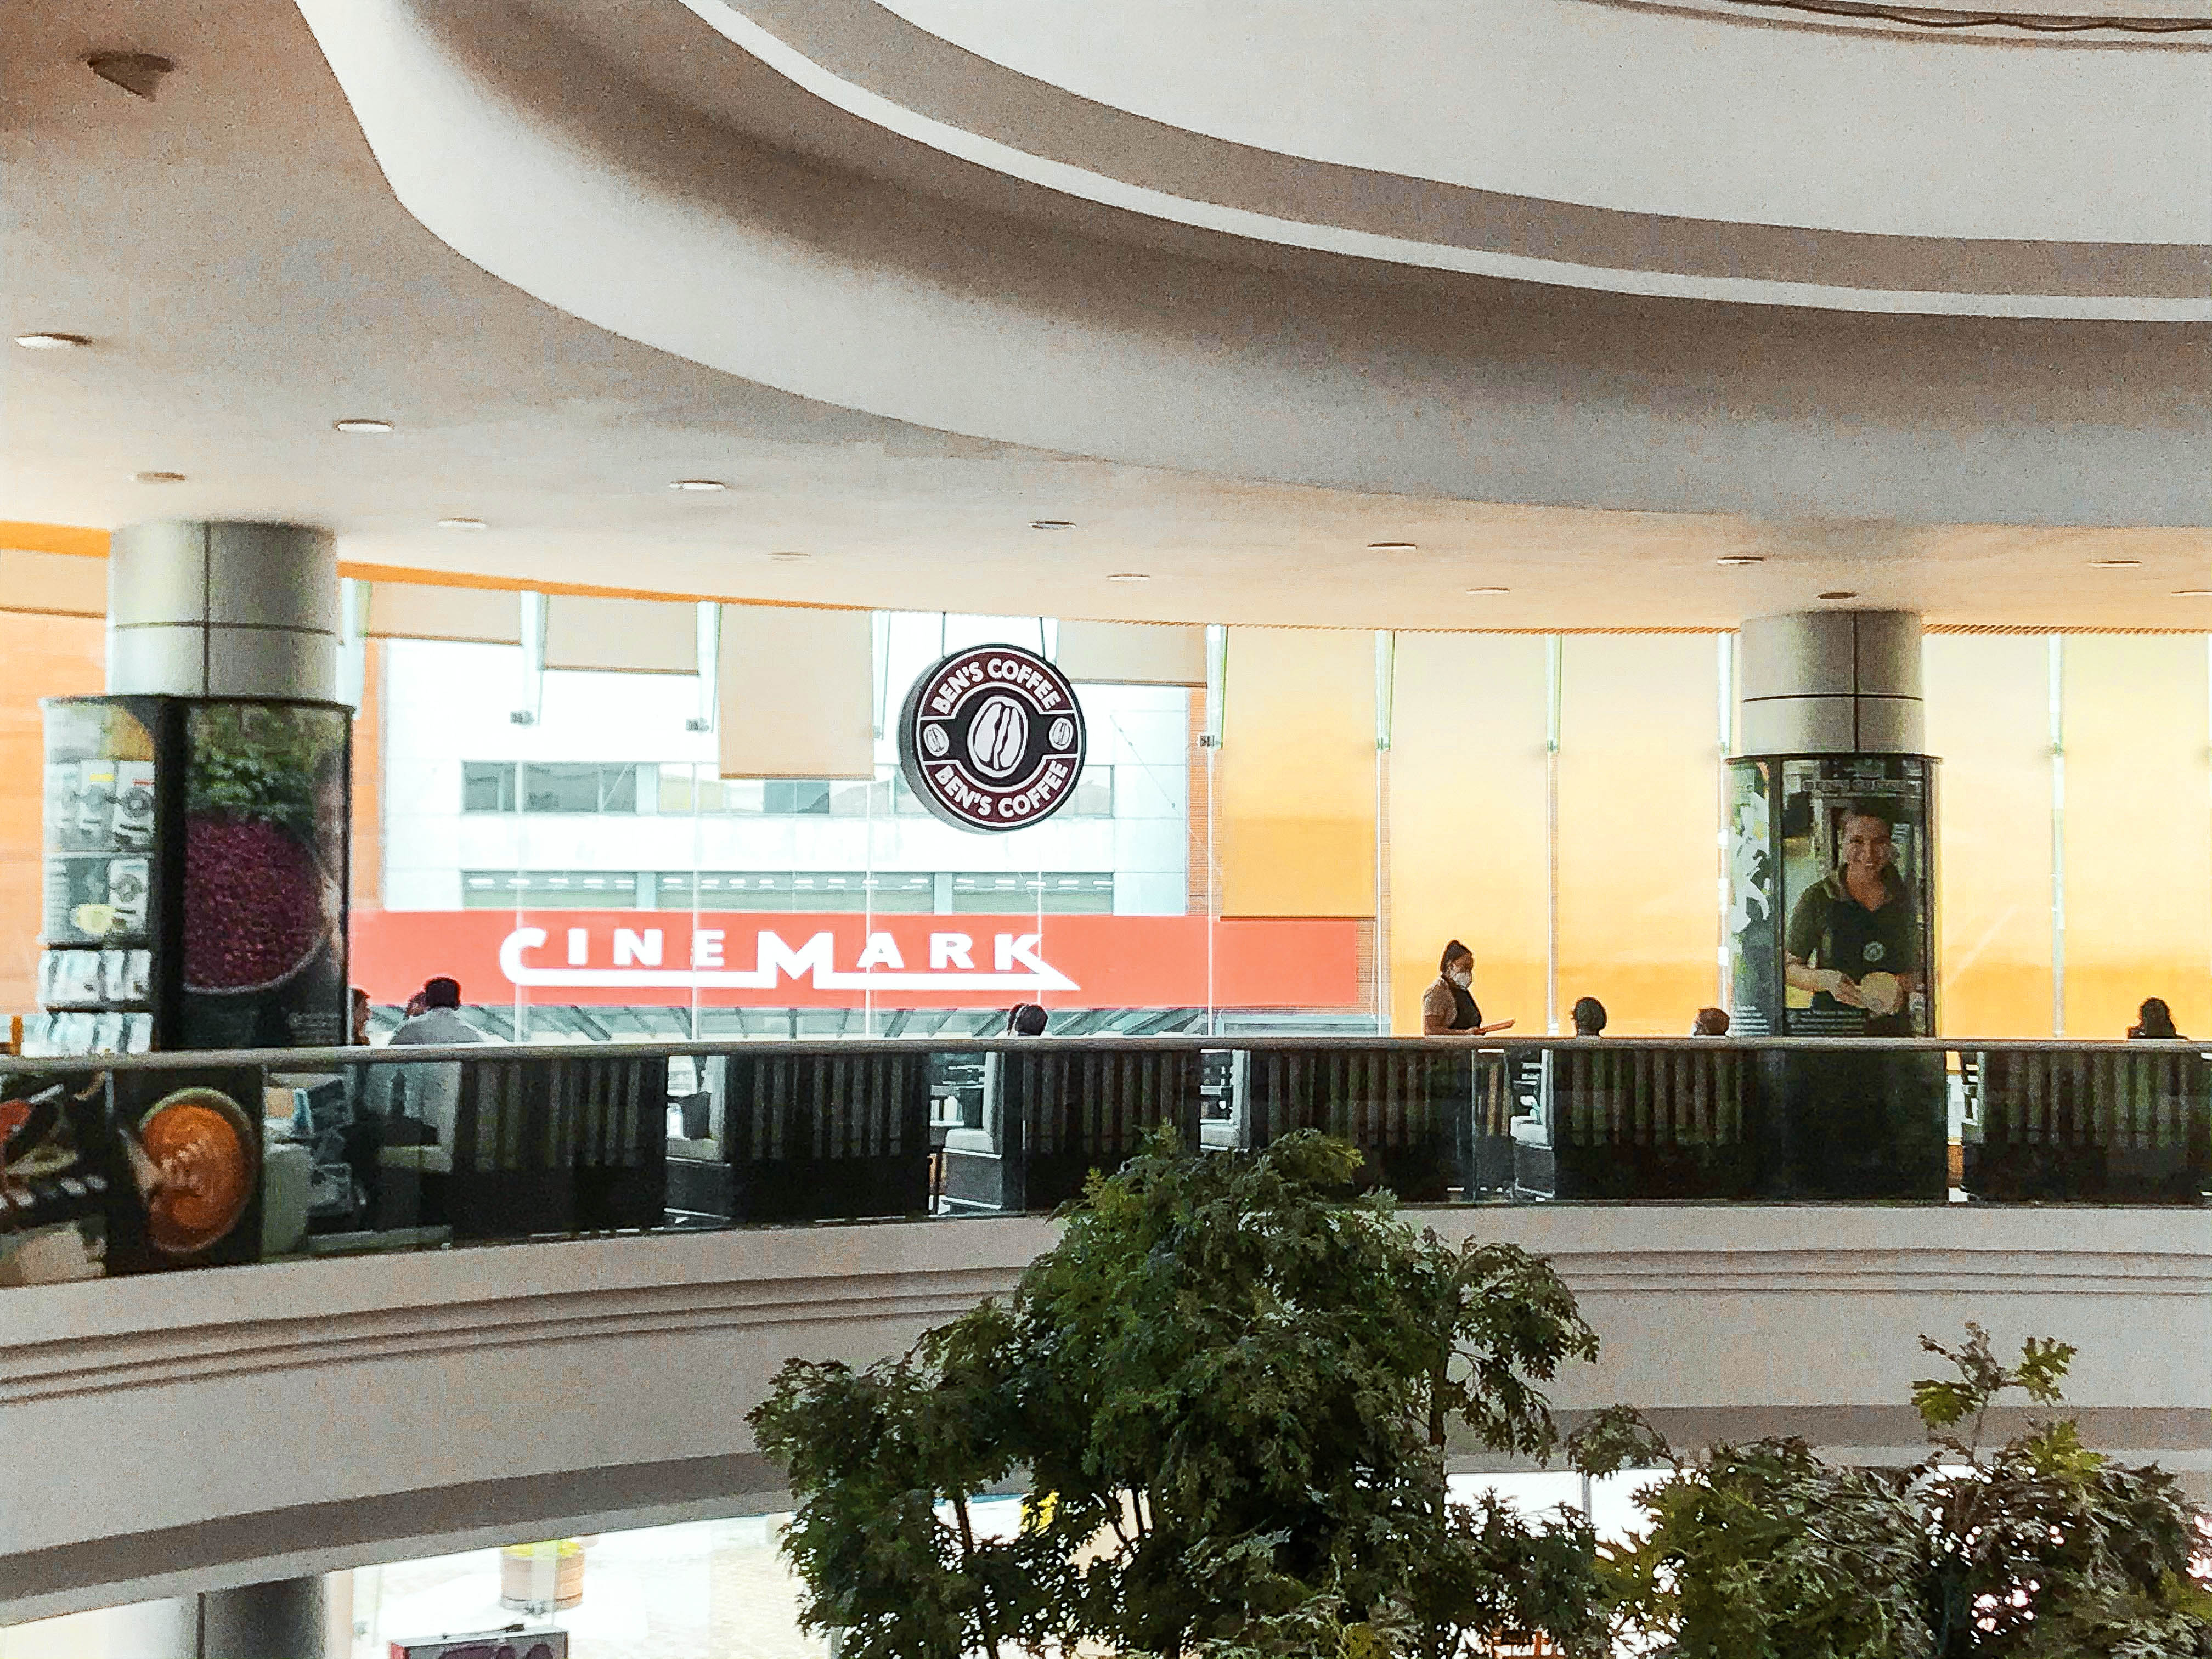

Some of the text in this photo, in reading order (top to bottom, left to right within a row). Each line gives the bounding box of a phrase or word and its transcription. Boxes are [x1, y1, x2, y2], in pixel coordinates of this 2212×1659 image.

[931, 658, 1062, 714] BEN'S COFFEE
[935, 760, 1068, 817] BEN'S COFFEE
[500, 928, 1080, 990] CINEMARK
